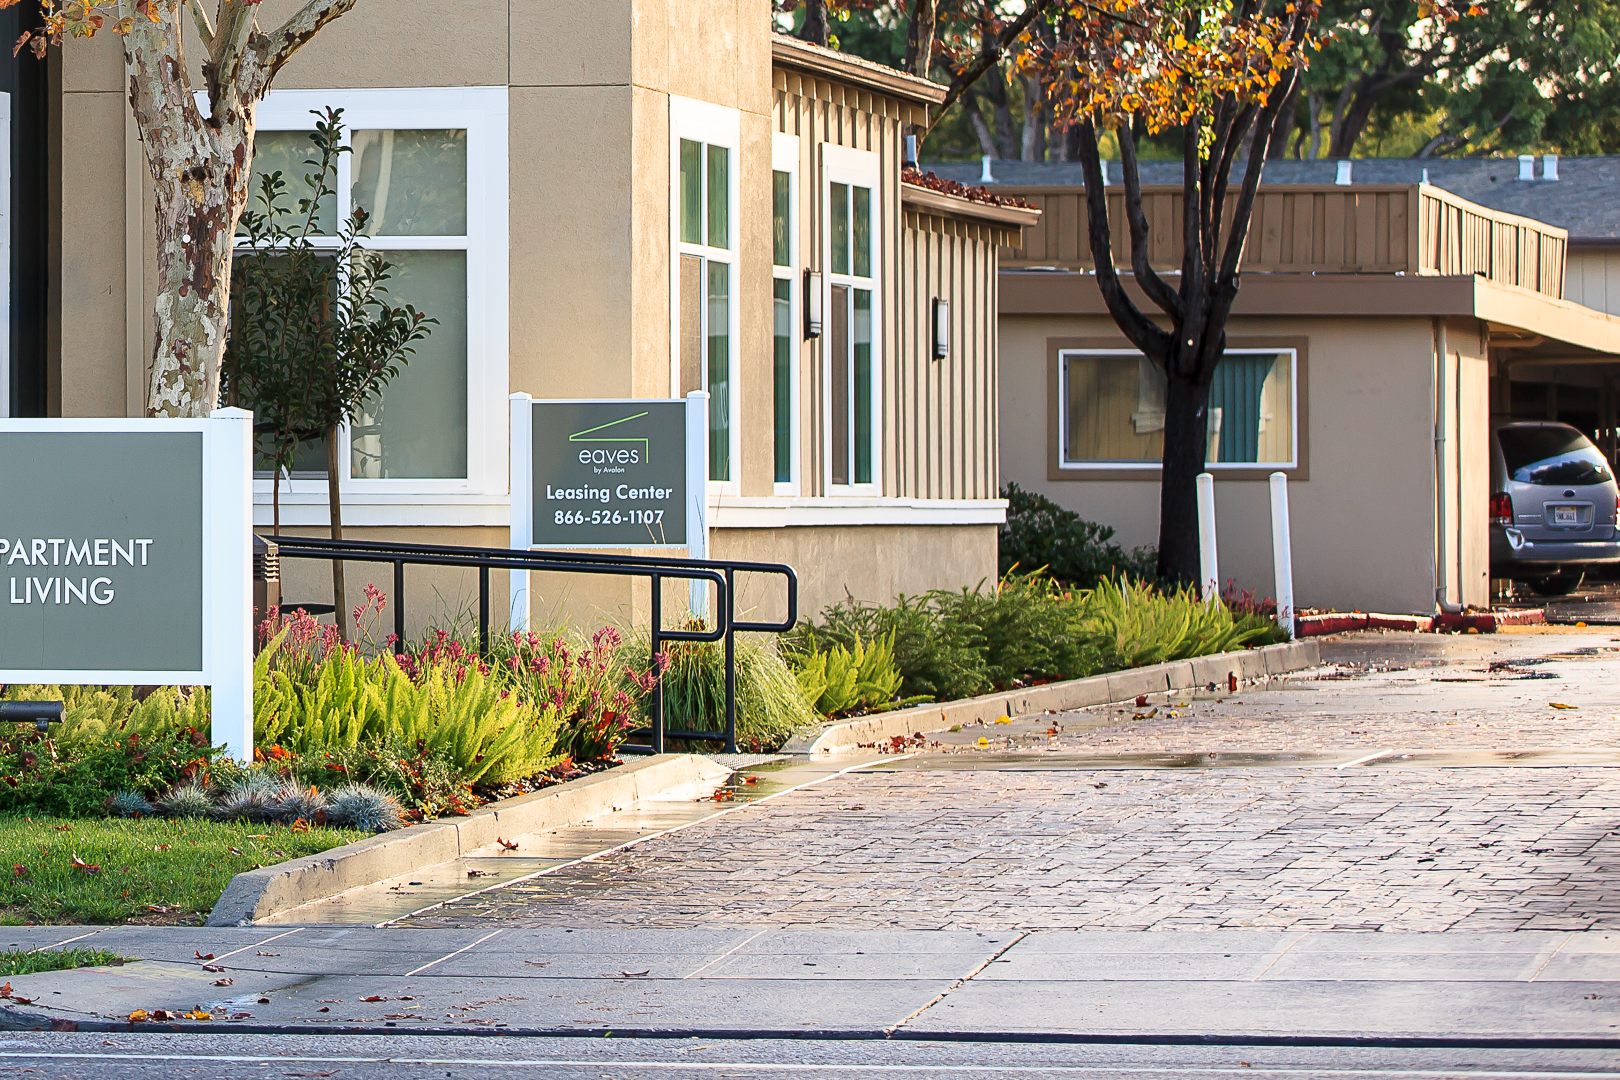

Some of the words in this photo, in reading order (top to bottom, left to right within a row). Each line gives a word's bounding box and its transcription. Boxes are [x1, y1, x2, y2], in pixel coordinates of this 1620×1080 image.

[578, 449, 639, 464] eaves
[594, 466, 602, 475] by
[603, 466, 625, 474] Avalon
[546, 484, 610, 503] Leasing
[616, 484, 673, 500] Center
[554, 510, 664, 525] 866-526-1107
[10, 576, 116, 606] LIVING
